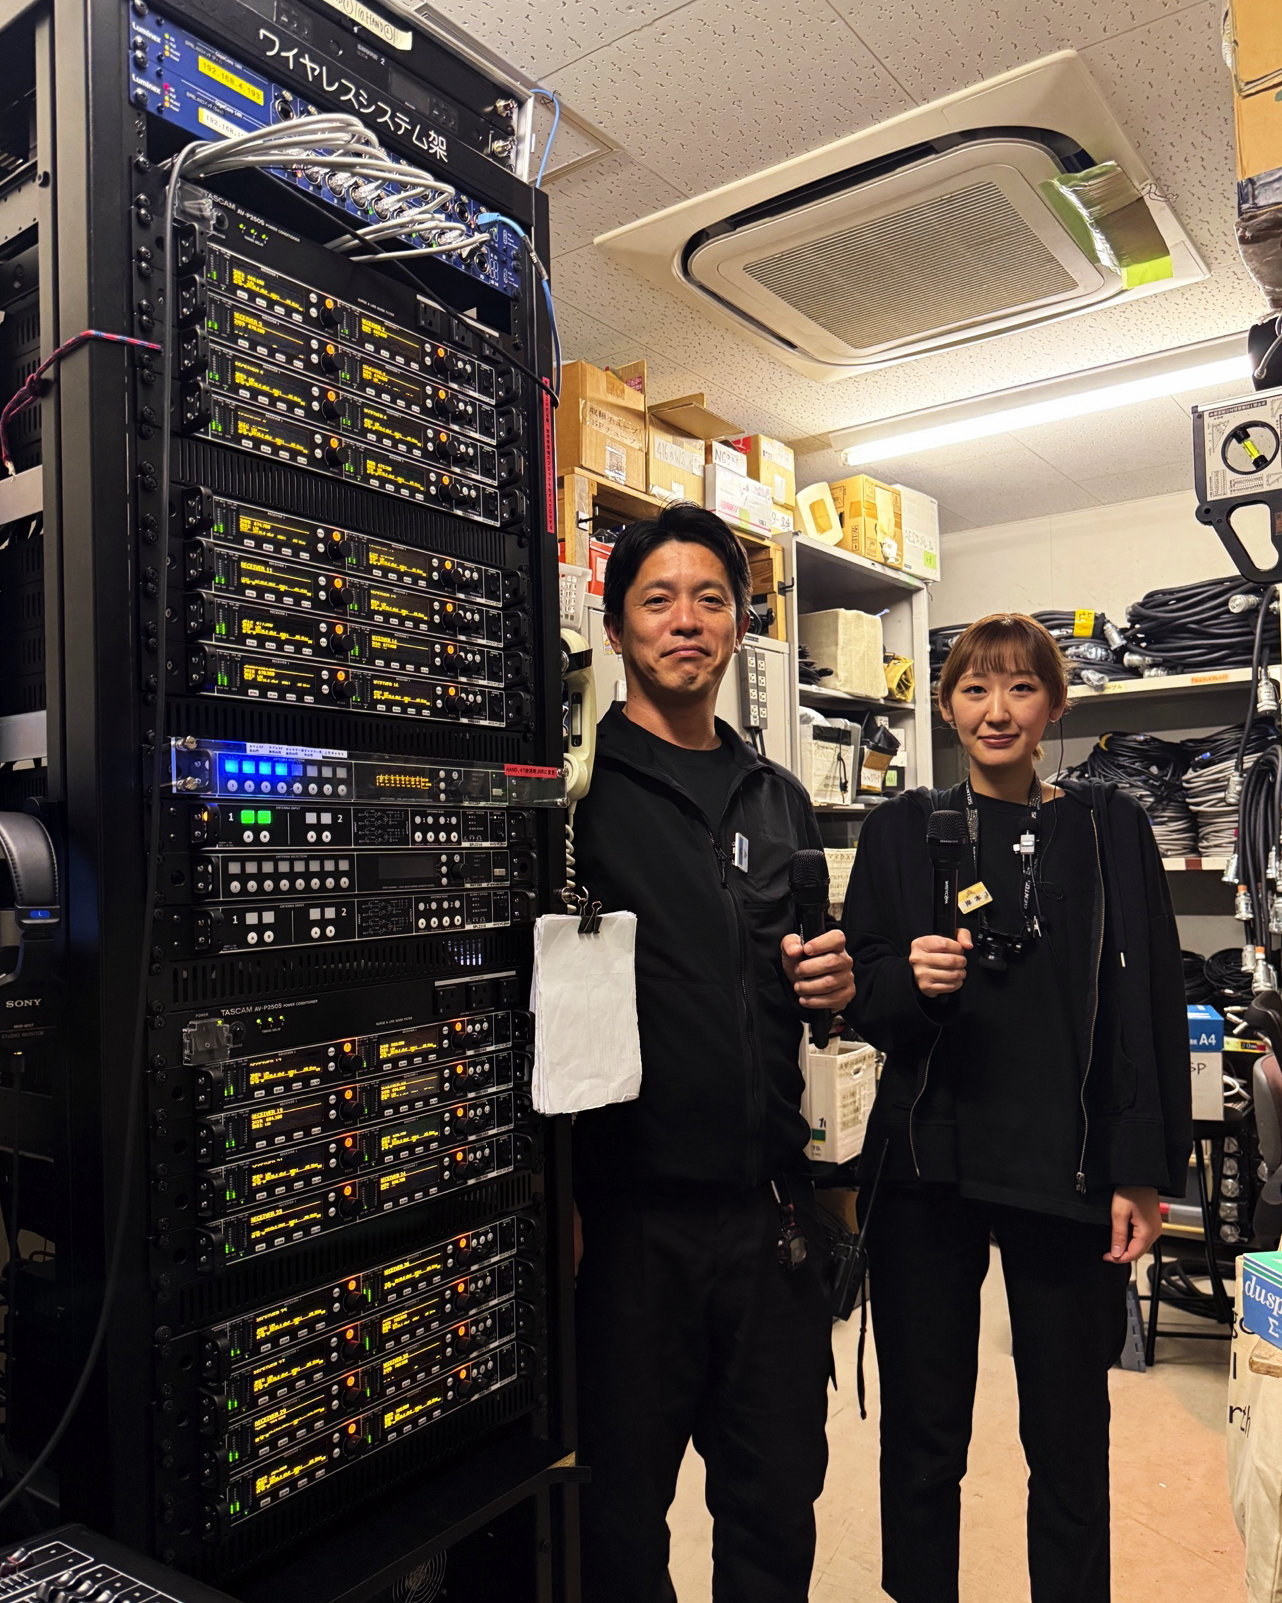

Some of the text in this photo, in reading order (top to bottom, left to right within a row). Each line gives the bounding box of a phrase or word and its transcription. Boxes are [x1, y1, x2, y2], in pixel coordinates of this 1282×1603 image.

[202, 62, 261, 101] 192.168.4.193
[258, 27, 449, 164] ワイヤレスシステム架
[228, 812, 234, 821] 1
[337, 815, 343, 823] 2
[341, 908, 347, 917] 2
[232, 915, 238, 924] 1
[6, 998, 42, 1008] SONY
[220, 1005, 253, 1017] TASCAM
[254, 1002, 282, 1012] AV-P250S
[1199, 1033, 1216, 1046] A4
